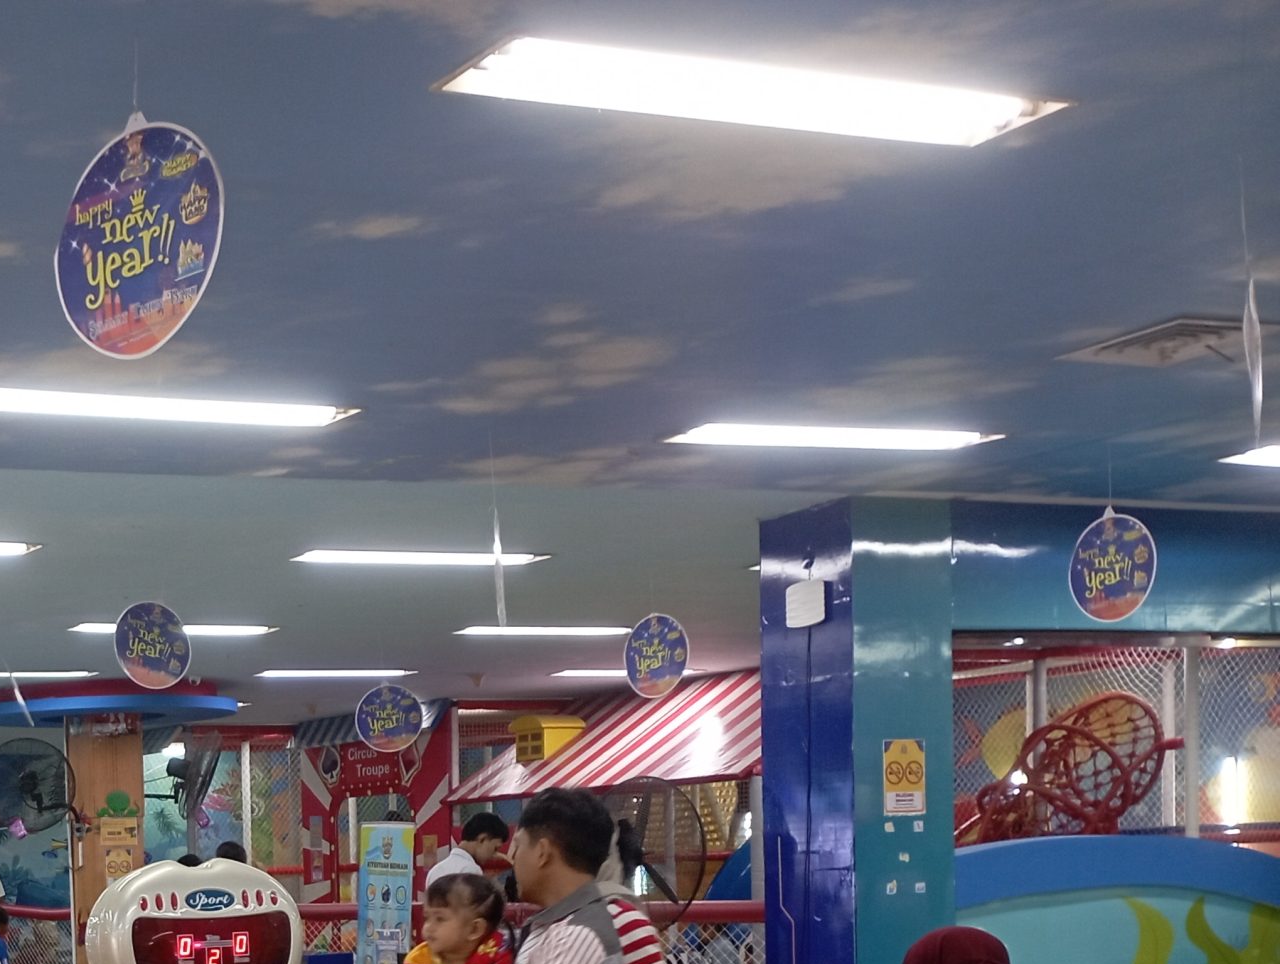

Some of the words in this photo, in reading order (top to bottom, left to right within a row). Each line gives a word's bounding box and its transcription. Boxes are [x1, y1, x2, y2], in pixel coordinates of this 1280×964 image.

[75, 198, 113, 229] happy
[101, 204, 160, 244] new
[348, 748, 377, 760] Circus
[356, 764, 390, 777] Troupe
[190, 892, 230, 908] Sport
[180, 937, 191, 956] 0
[236, 935, 247, 953] 0
